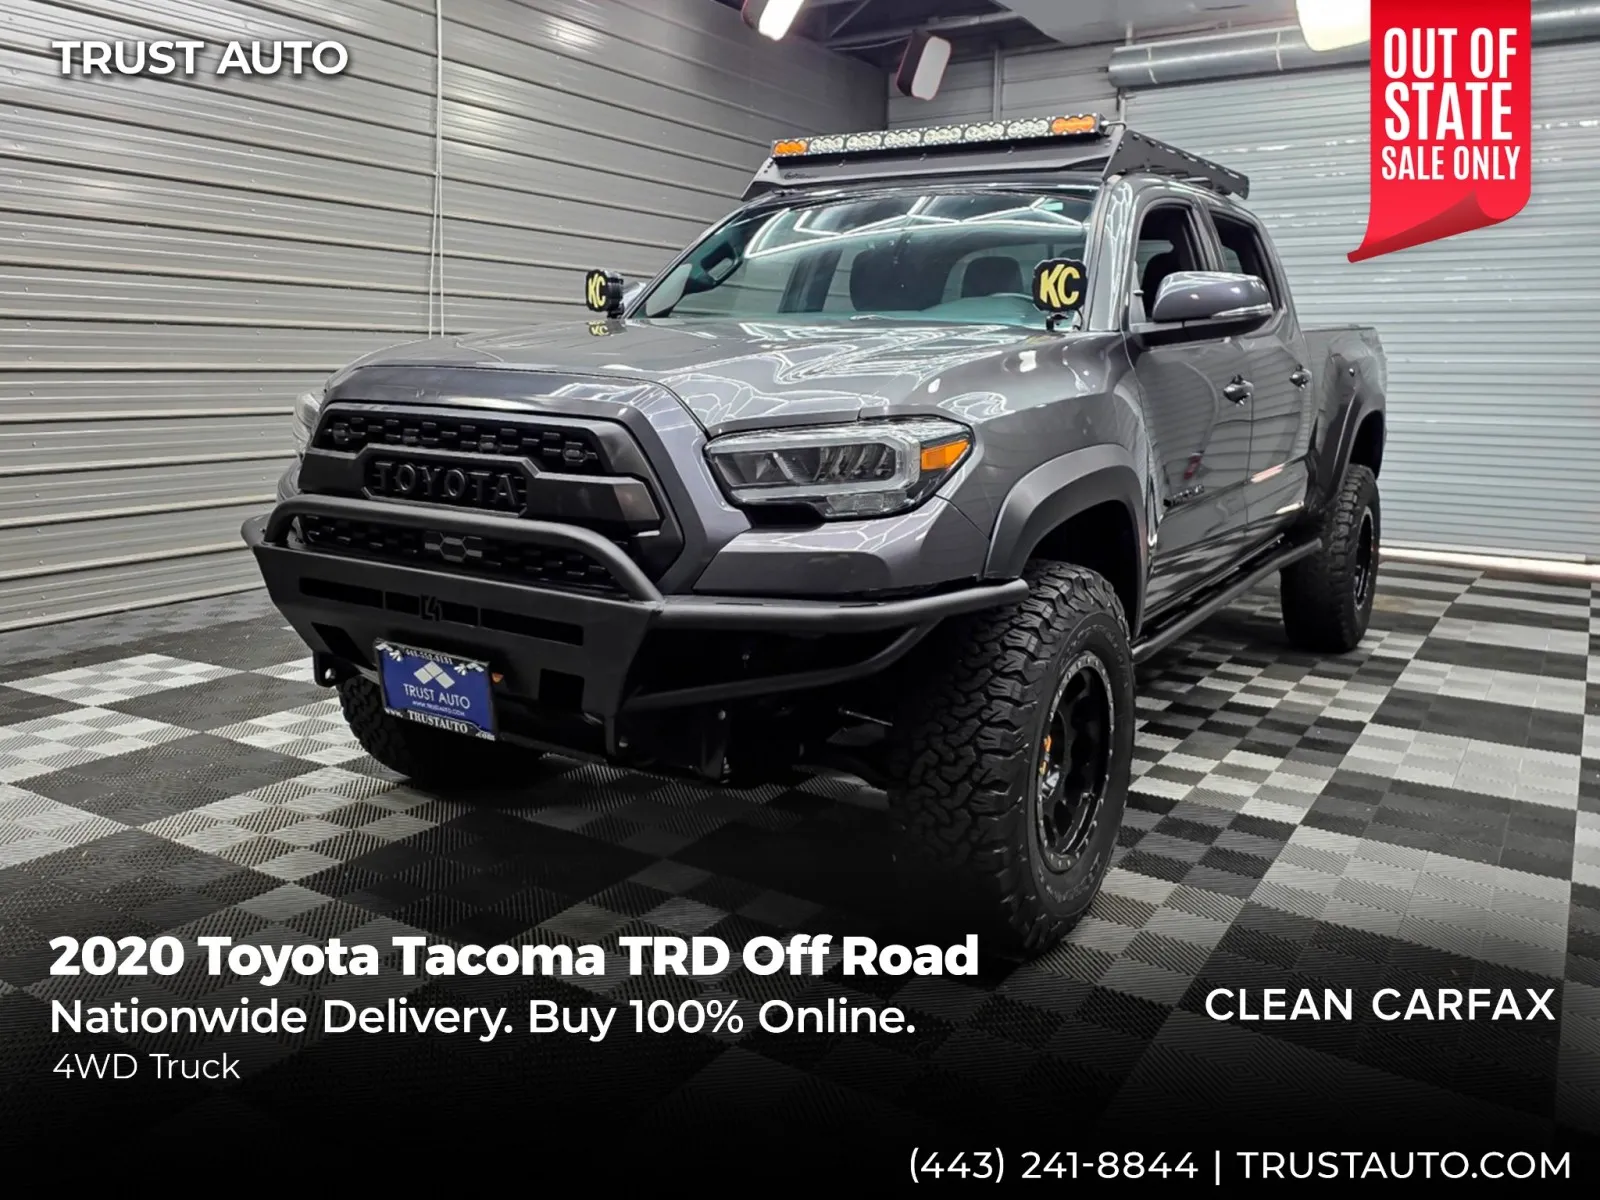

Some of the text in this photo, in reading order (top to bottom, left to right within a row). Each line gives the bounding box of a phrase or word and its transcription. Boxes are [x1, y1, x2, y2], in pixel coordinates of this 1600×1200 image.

[588, 273, 606, 308] KC
[1040, 264, 1081, 308] KC
[374, 461, 518, 506] TOYOTA
[403, 683, 470, 709] TRUST AUTO
[407, 709, 468, 734] TRUSTAUTO
